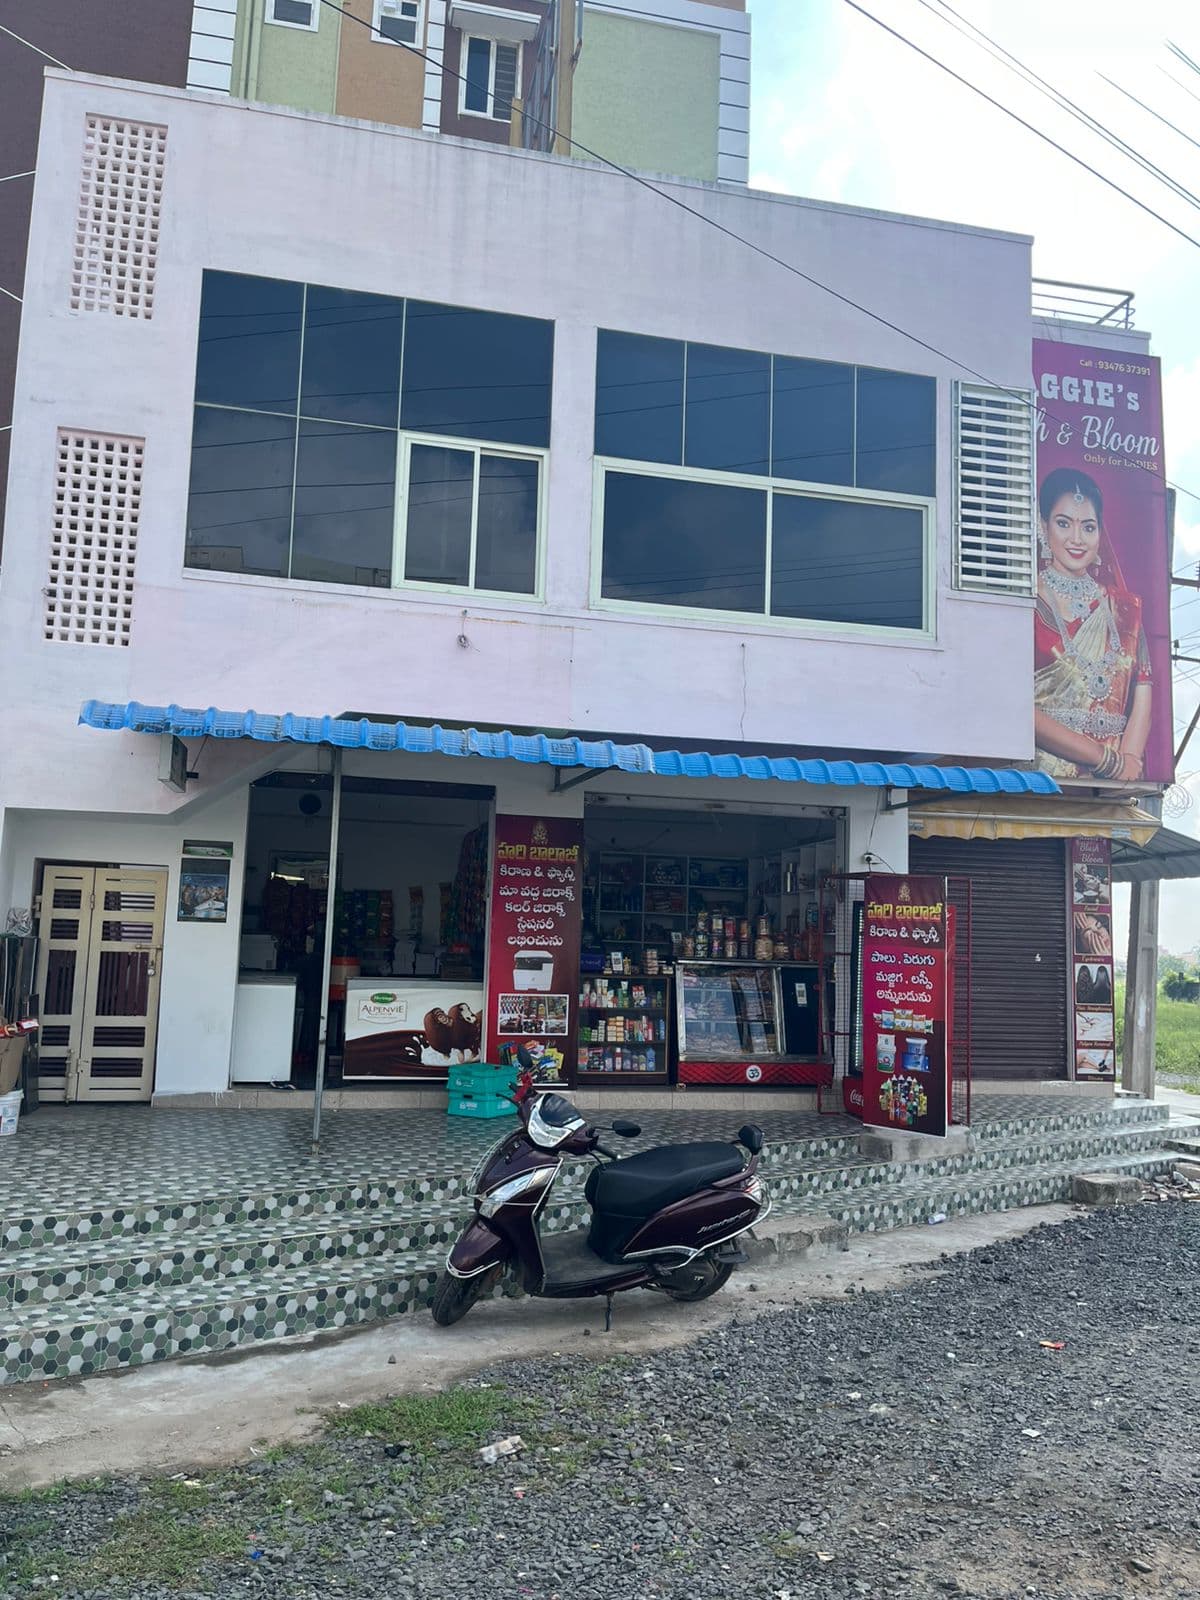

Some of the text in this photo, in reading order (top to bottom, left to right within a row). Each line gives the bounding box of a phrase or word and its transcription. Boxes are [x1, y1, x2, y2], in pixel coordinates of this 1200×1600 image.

[1037, 372, 1140, 412] GGIE's
[1056, 423, 1073, 445] &
[1081, 416, 1160, 456] Bloom
[1084, 453, 1106, 466] Only
[1108, 456, 1122, 466] for
[500, 886, 519, 896] మా
[505, 900, 531, 912] కలర్
[507, 935, 564, 947] లభించును
[870, 951, 936, 966] పాలు పెరుగు
[876, 971, 904, 988] మజ్జిగ
